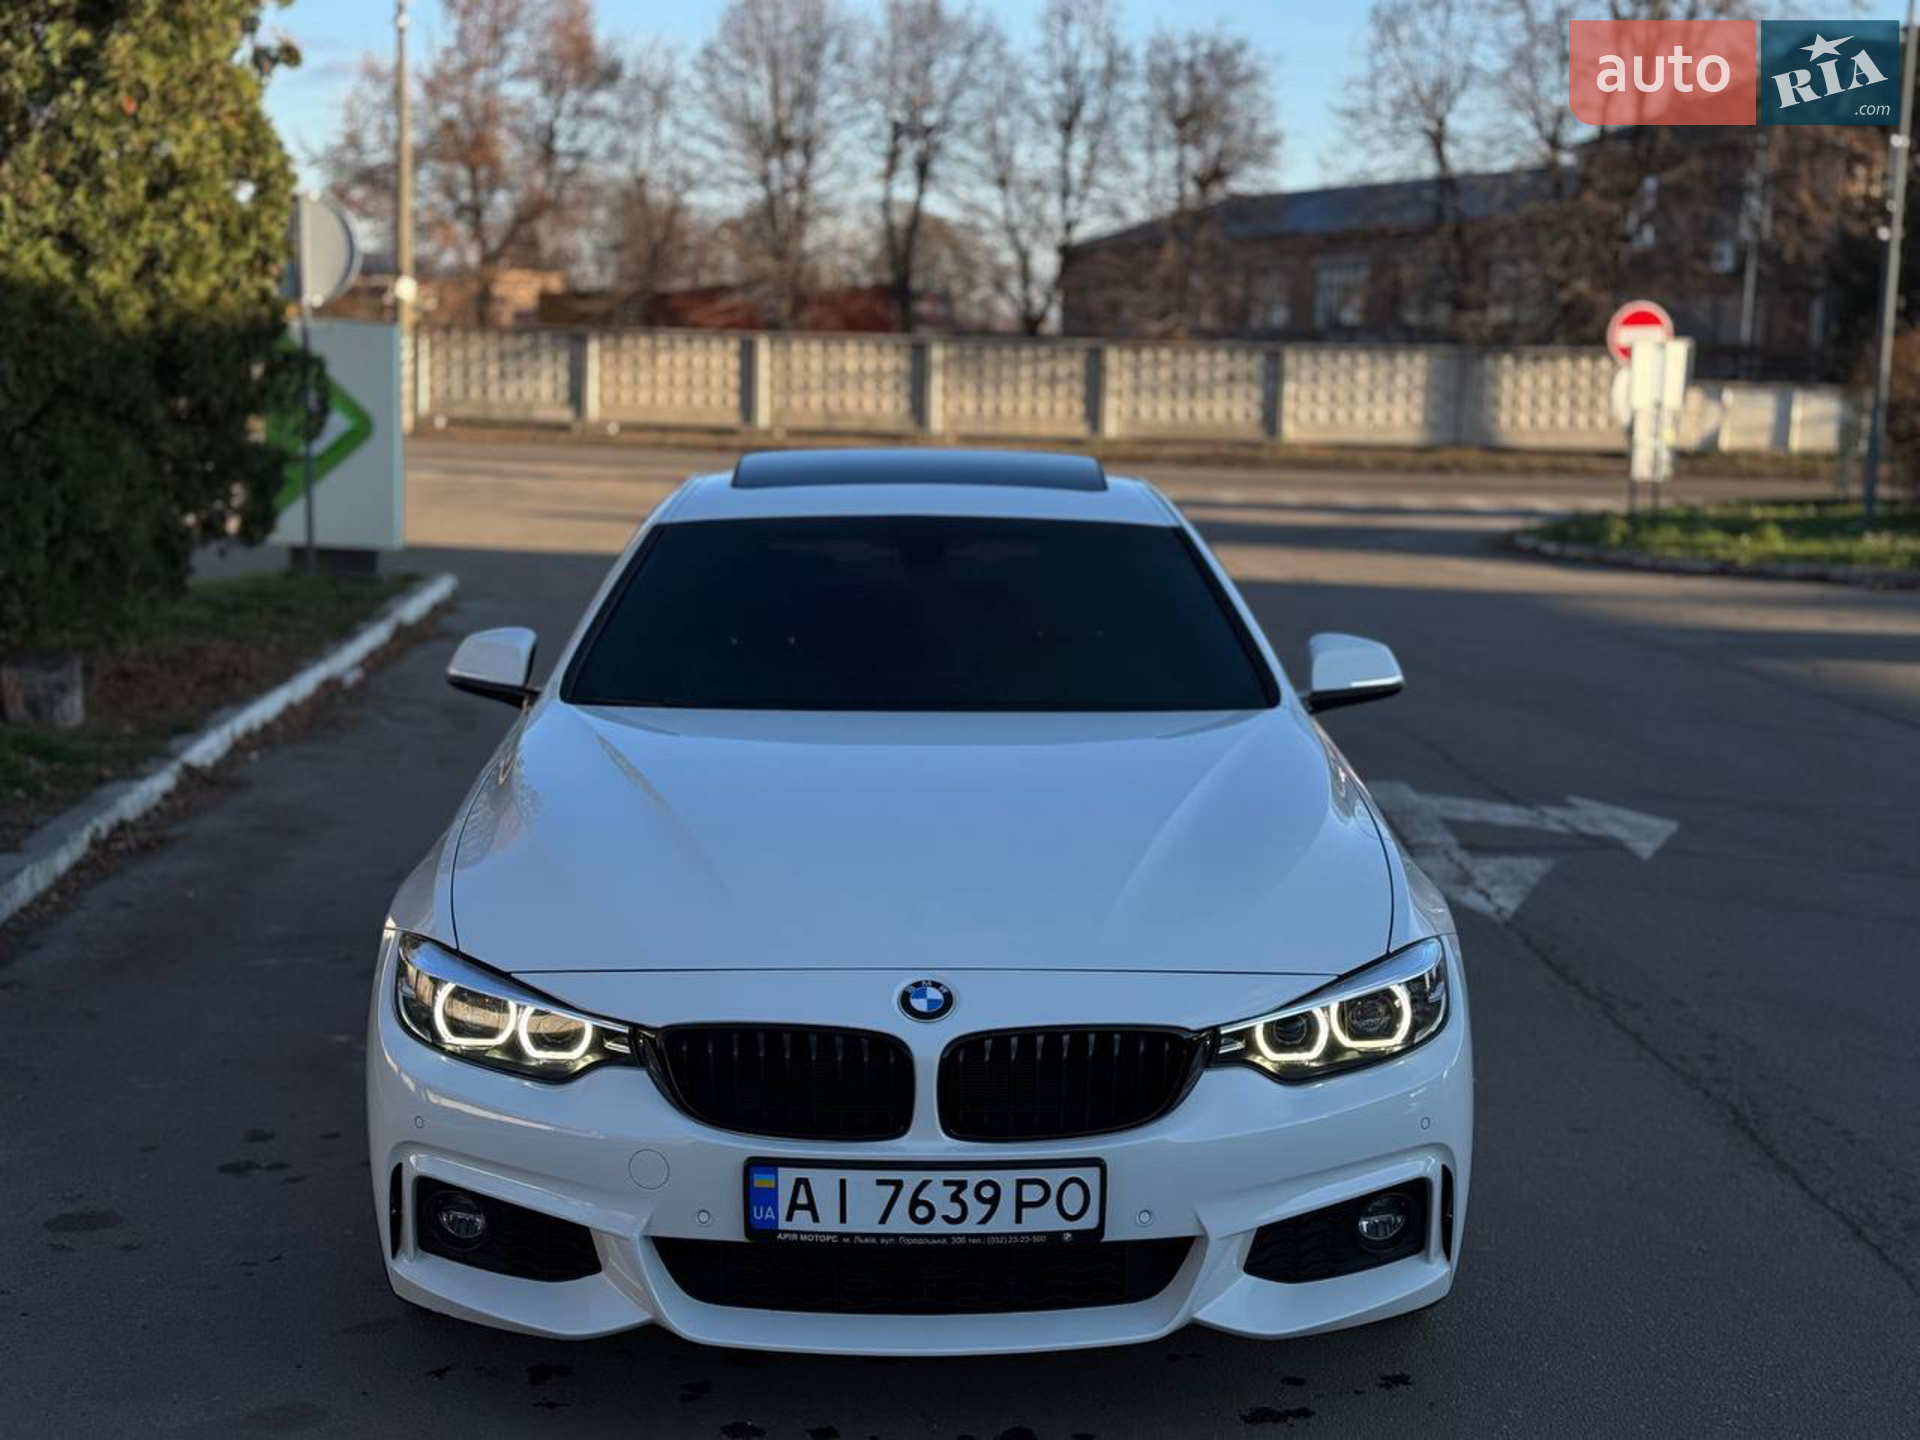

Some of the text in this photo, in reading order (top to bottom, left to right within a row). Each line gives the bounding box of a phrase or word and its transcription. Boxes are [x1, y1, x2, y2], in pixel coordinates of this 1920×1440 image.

[786, 1177, 848, 1225] AI
[875, 1178, 1001, 1225] 7639
[753, 1205, 776, 1221] UA
[799, 1233, 839, 1243] МОТОРС
